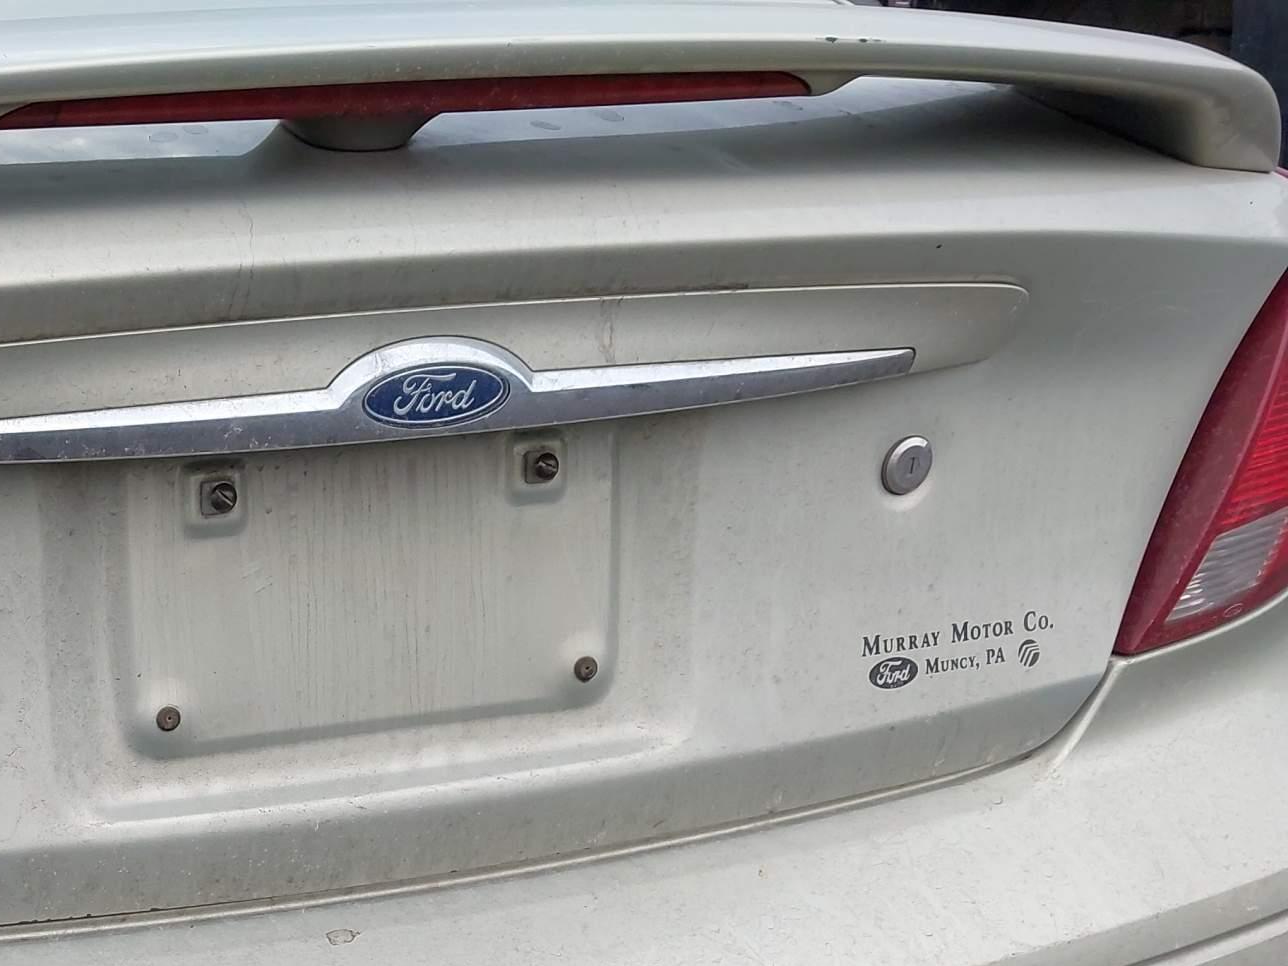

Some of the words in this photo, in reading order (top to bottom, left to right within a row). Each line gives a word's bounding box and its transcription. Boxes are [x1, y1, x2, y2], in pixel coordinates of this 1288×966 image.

[393, 372, 477, 415] Ford
[986, 647, 1006, 665] PA
[876, 659, 911, 685] Ford
